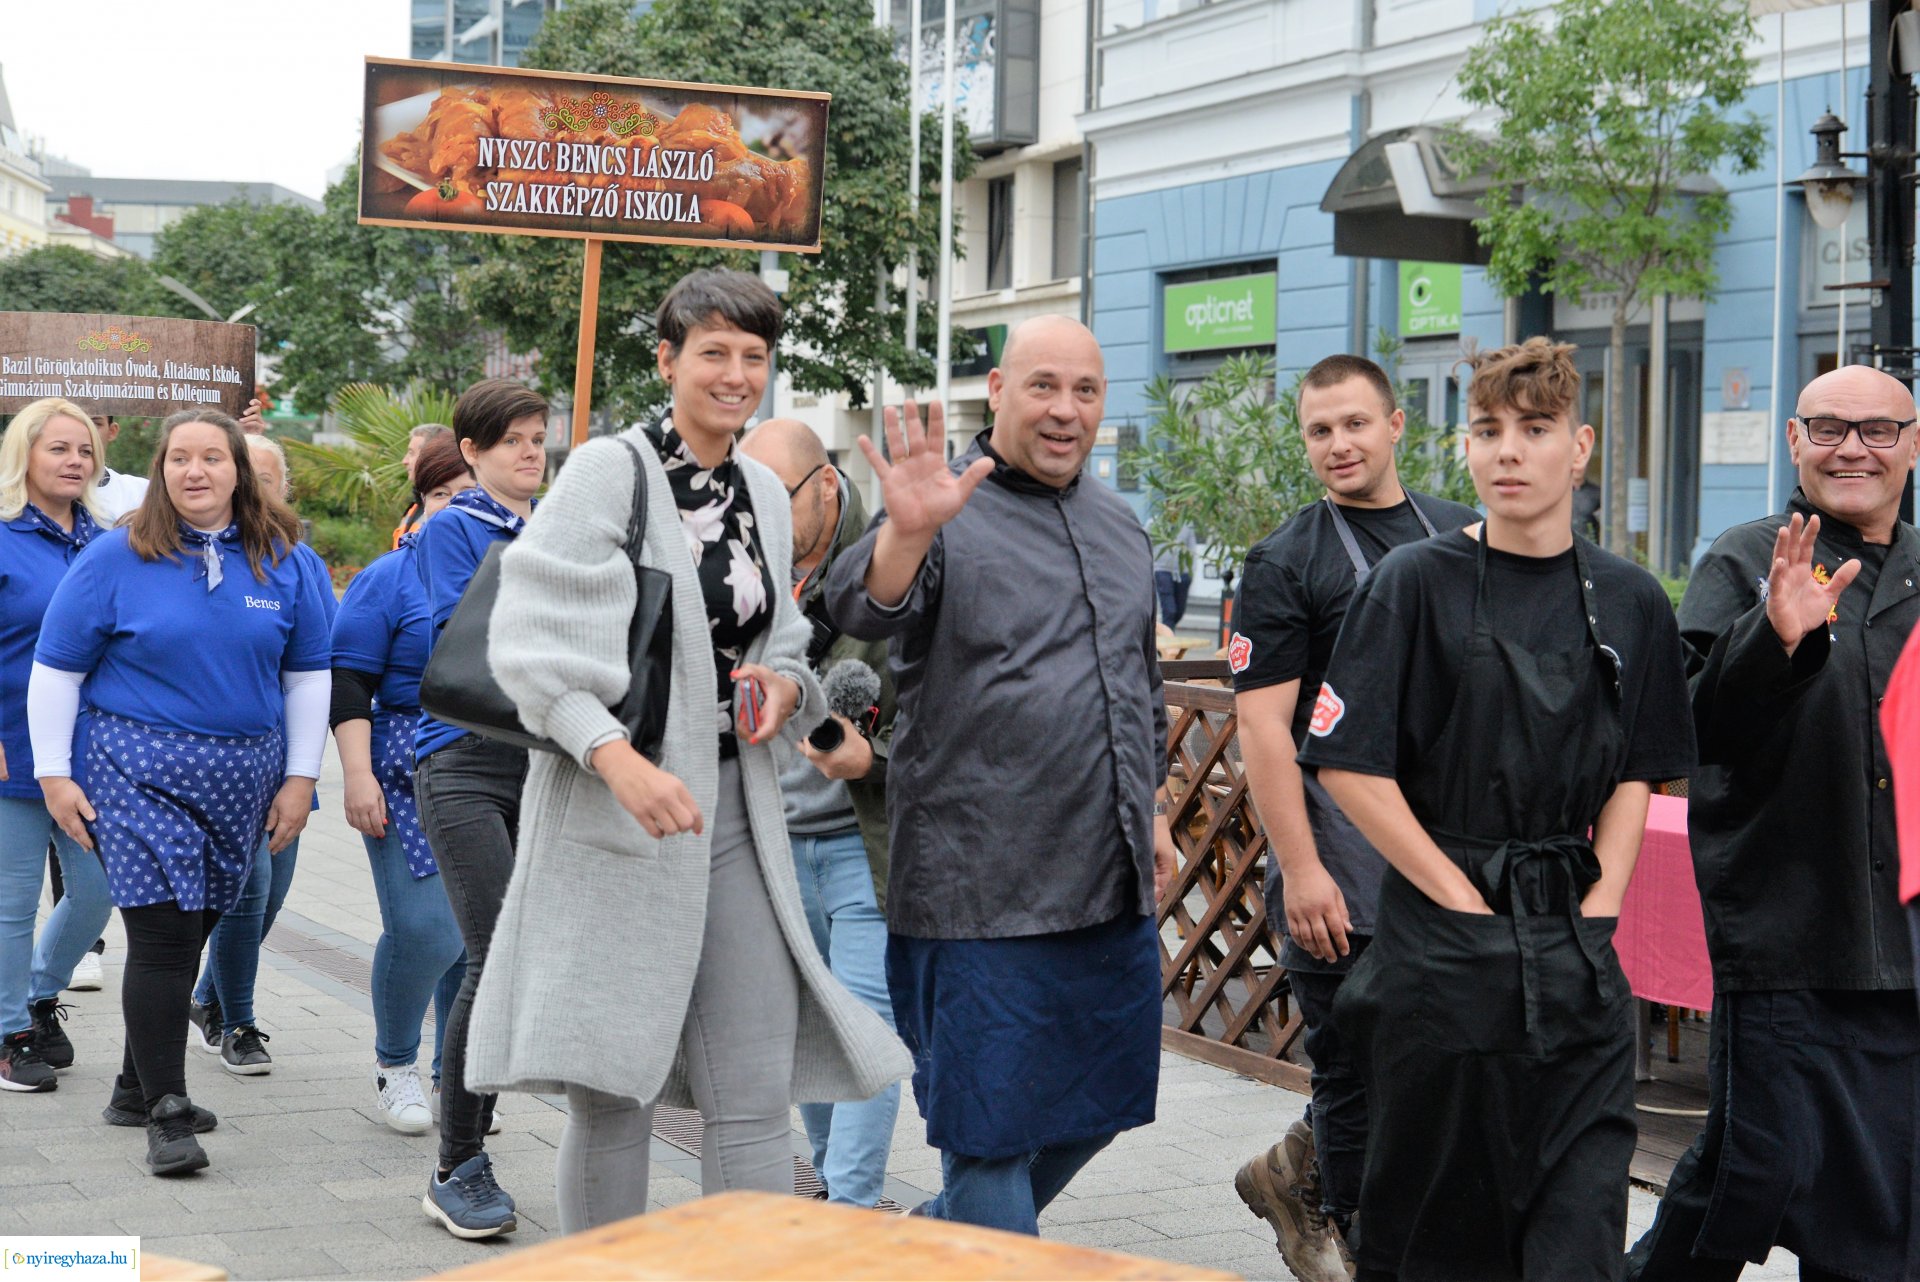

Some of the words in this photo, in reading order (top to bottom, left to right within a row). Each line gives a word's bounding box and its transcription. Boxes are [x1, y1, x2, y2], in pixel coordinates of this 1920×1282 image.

[478, 137, 550, 170] NYSZC
[556, 142, 627, 176] BENCS
[632, 145, 714, 182] LÁSZLÓ
[486, 181, 620, 218] SZAKKÉPZŐ
[624, 190, 702, 223] ISKOLA
[1185, 289, 1254, 334] opticnet
[1409, 314, 1460, 331] OPTIKA
[2, 356, 32, 375] Bazil
[35, 357, 123, 378] Görögkatolikus
[125, 357, 161, 380] Óvoda,
[163, 359, 211, 381] Általános
[212, 364, 242, 386] Iskola,
[65, 379, 155, 400] Szakgimnázium
[157, 383, 169, 400] és
[171, 383, 221, 405] Kollégium
[244, 596, 280, 611] Bencs
